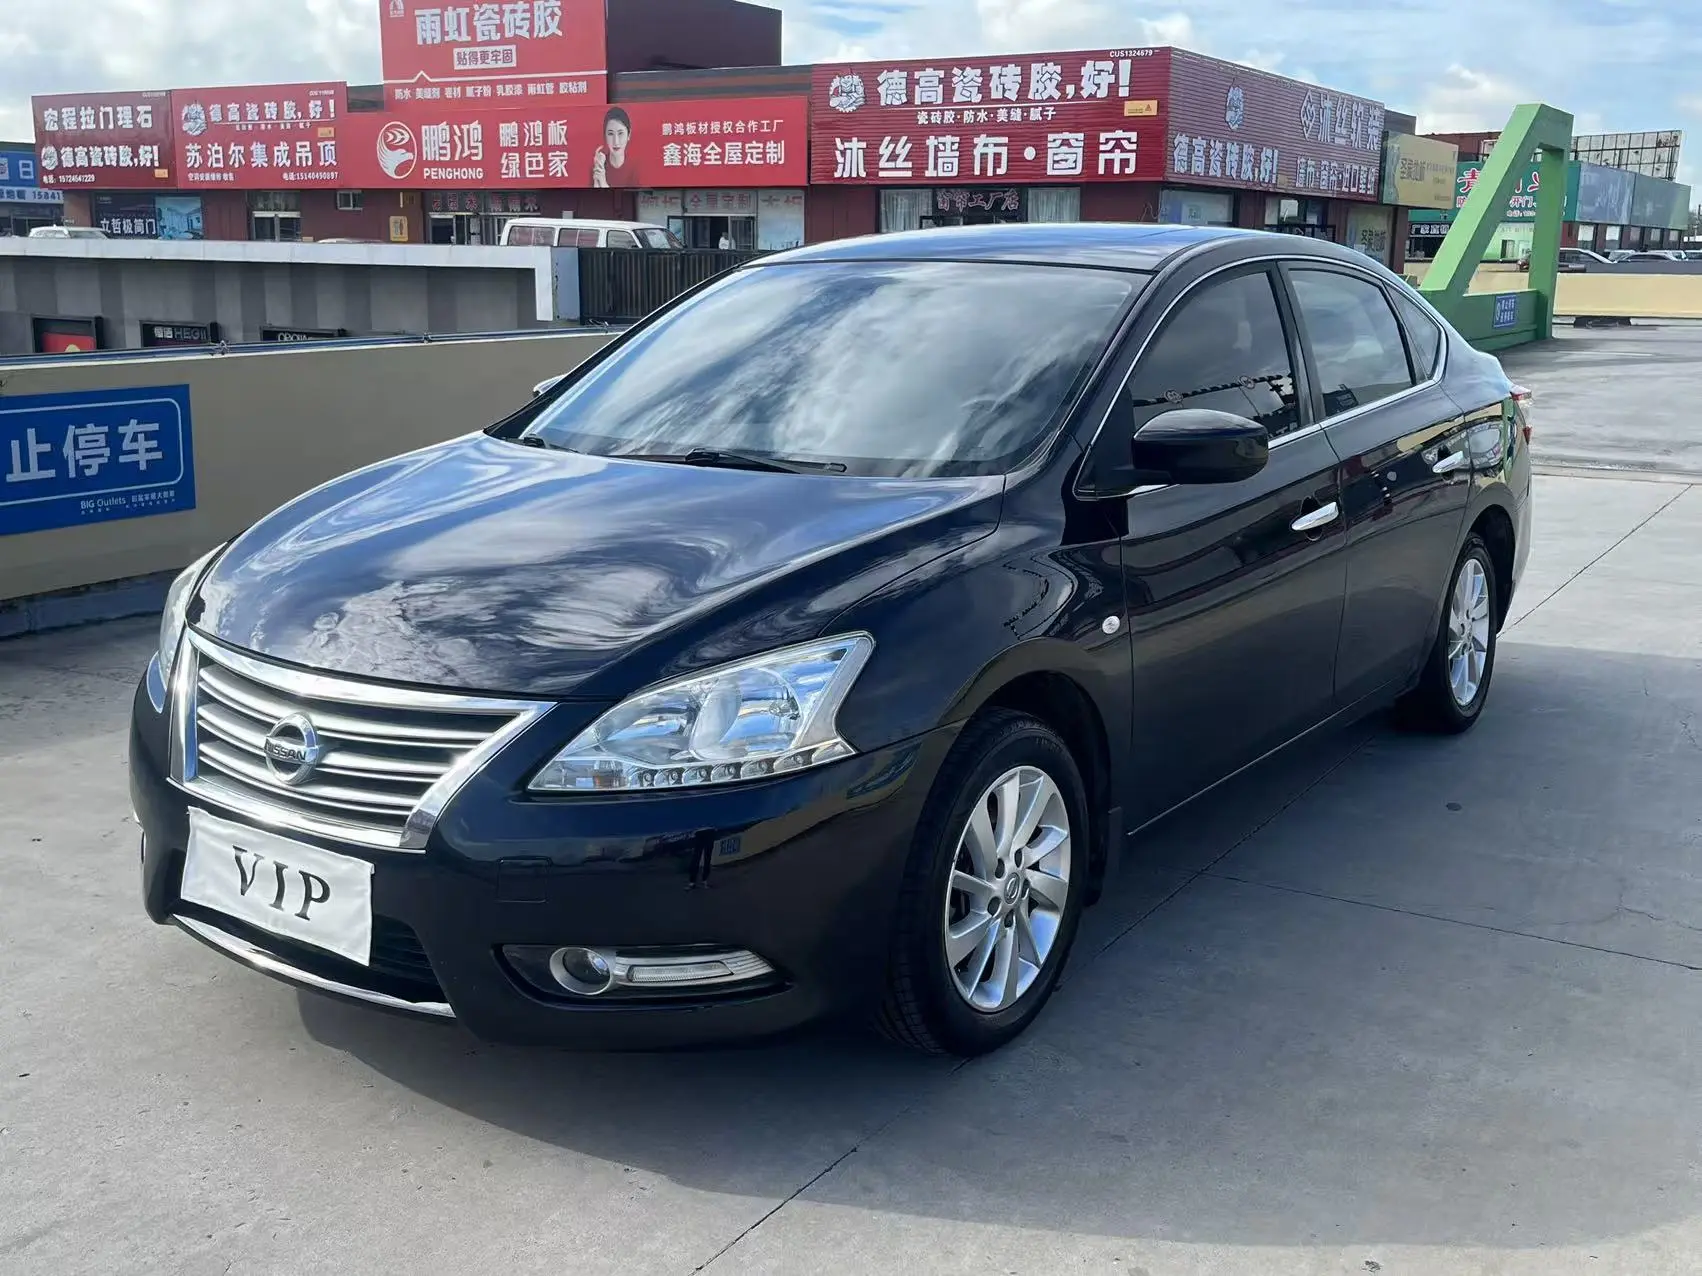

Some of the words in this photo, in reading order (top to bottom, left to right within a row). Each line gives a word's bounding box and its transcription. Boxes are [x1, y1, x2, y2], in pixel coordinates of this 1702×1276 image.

[414, 1, 563, 45] 雨虹瓷砖胶
[421, 120, 483, 161] 鹏鸿
[499, 119, 569, 147] 鹏鸿板
[662, 119, 784, 136] 鹏鸿板材授权合作工厂
[185, 140, 338, 169] 苏泊尔集成吊顶
[500, 150, 569, 179] 绿色家
[662, 140, 785, 166] 鑫海全屋定制
[423, 167, 484, 180] PENGHONG
[100, 217, 157, 235] 立哲极简门
[6, 418, 163, 483] 止停车
[264, 738, 307, 762] NISSAN
[232, 844, 332, 921] VIP
